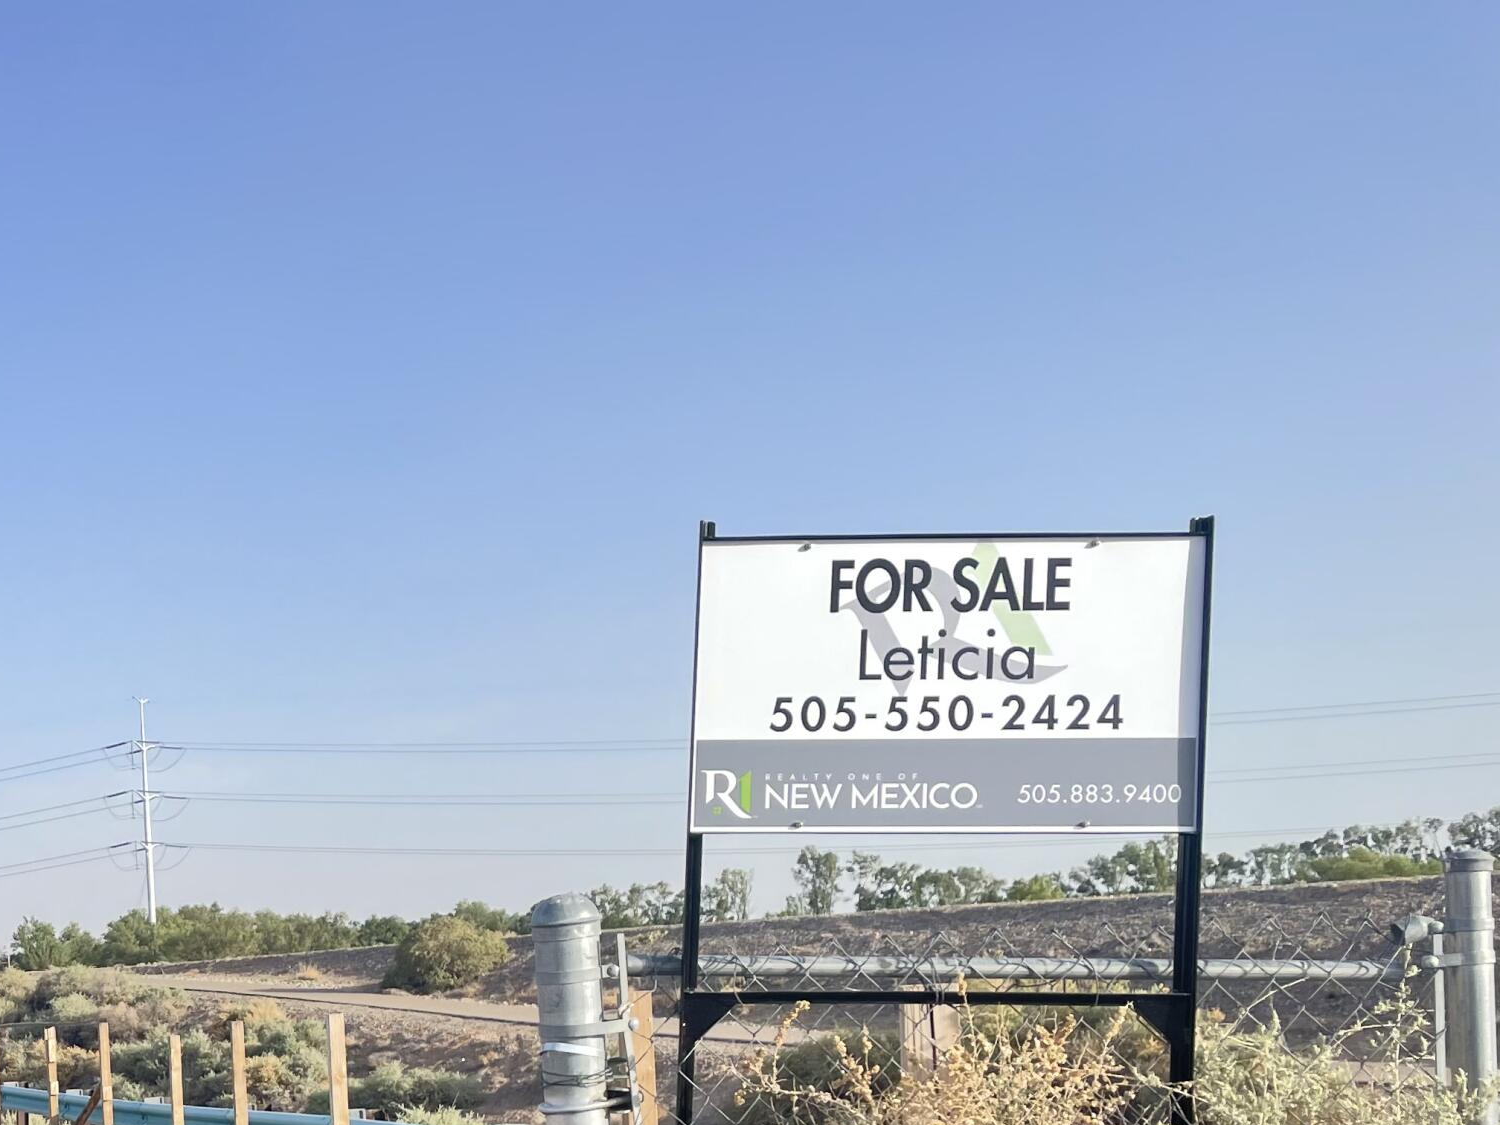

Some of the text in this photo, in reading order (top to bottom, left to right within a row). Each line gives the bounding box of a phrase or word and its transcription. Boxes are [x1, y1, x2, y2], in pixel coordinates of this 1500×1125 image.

[829, 556, 1073, 613] FOR SALE
[858, 628, 1036, 681] Leticia
[769, 694, 1124, 733] 505-550-2424
[764, 772, 919, 781] REALTY ONE OF
[764, 782, 978, 809] NEW MEXICO
[1017, 783, 1183, 805] 505.883.9400
